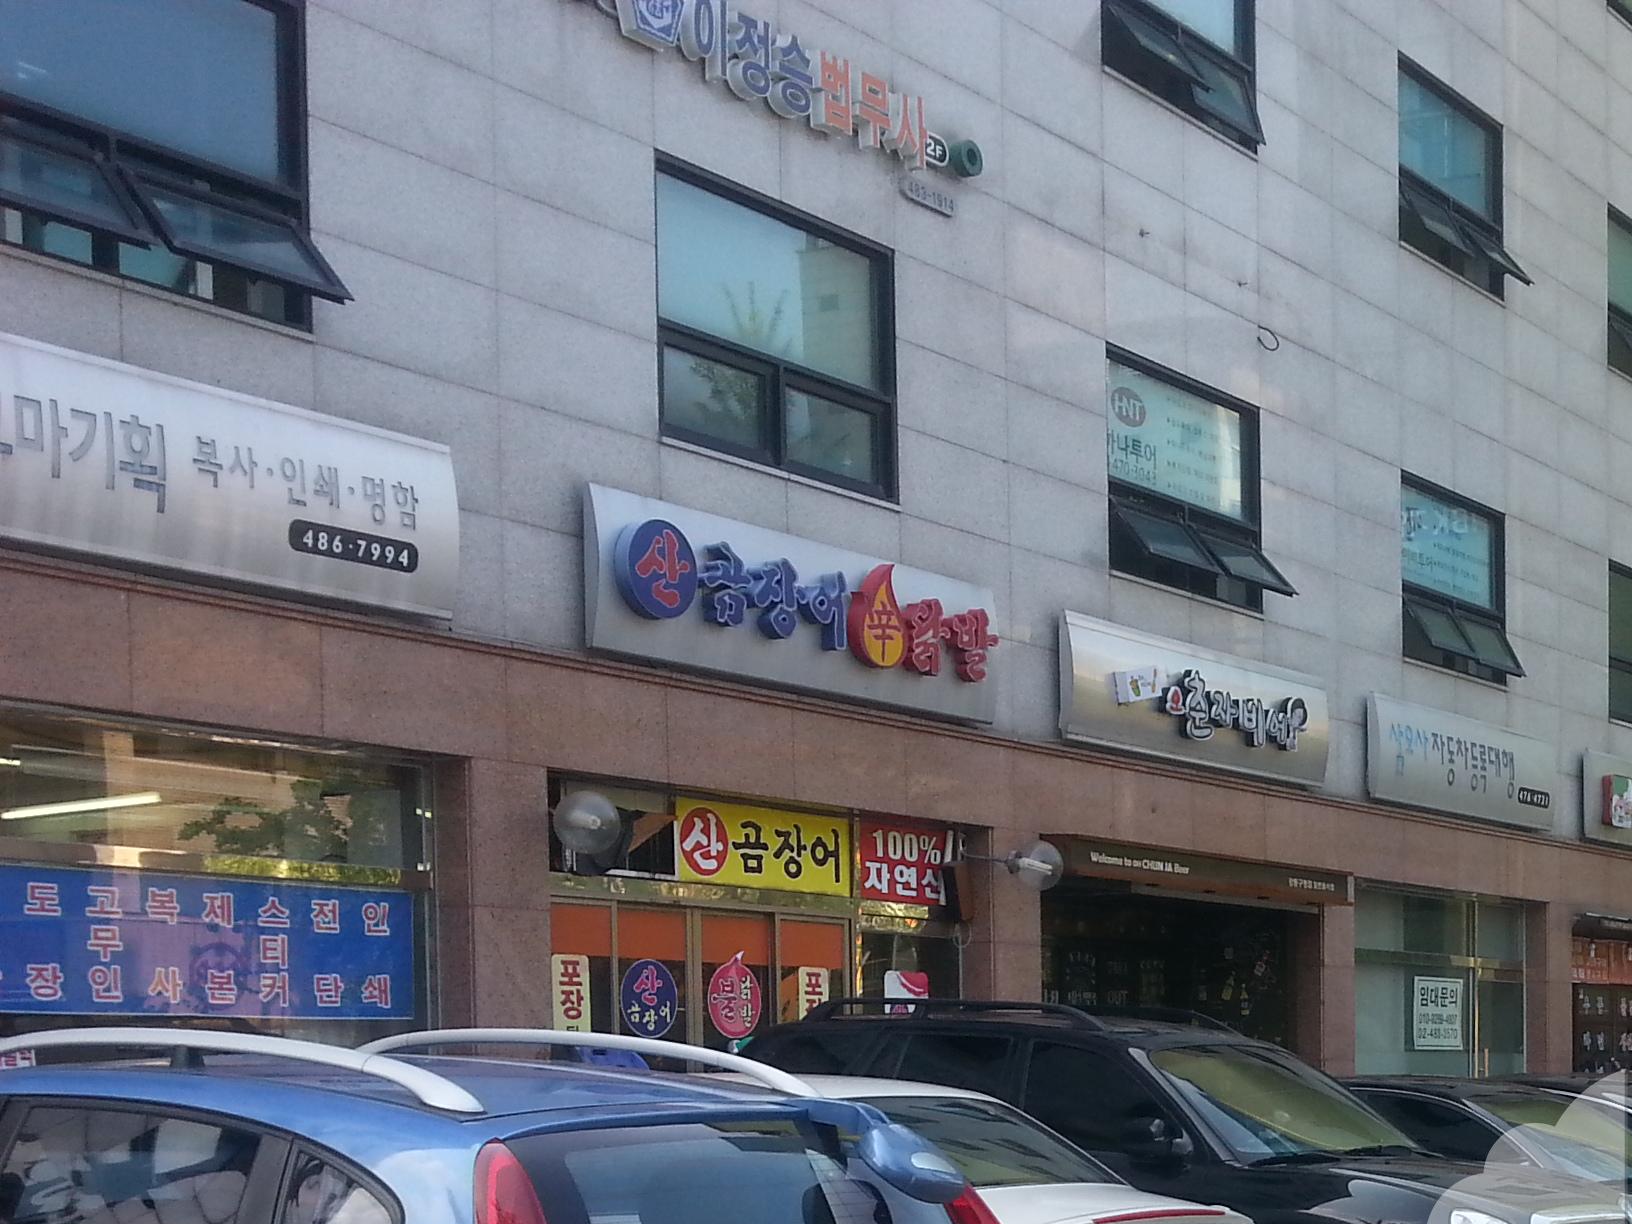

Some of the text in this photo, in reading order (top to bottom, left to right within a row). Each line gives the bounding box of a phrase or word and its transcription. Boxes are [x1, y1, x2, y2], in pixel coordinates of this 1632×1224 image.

[819, 50, 927, 170] 법무사
[925, 136, 944, 158] 2F
[0, 393, 166, 514] 마기획
[700, 541, 848, 651] 곰장어
[902, 598, 1000, 683] 닭발
[1183, 668, 1291, 749] 춘자비어
[1431, 731, 1515, 799] 자동차등록대행
[680, 811, 842, 884] 산 곰장어
[871, 829, 942, 865] 100%
[558, 959, 585, 1021] 포장
[626, 999, 672, 1032] 곰장어
[632, 964, 665, 1007] 산
[1419, 986, 1458, 1008] 임대문의
